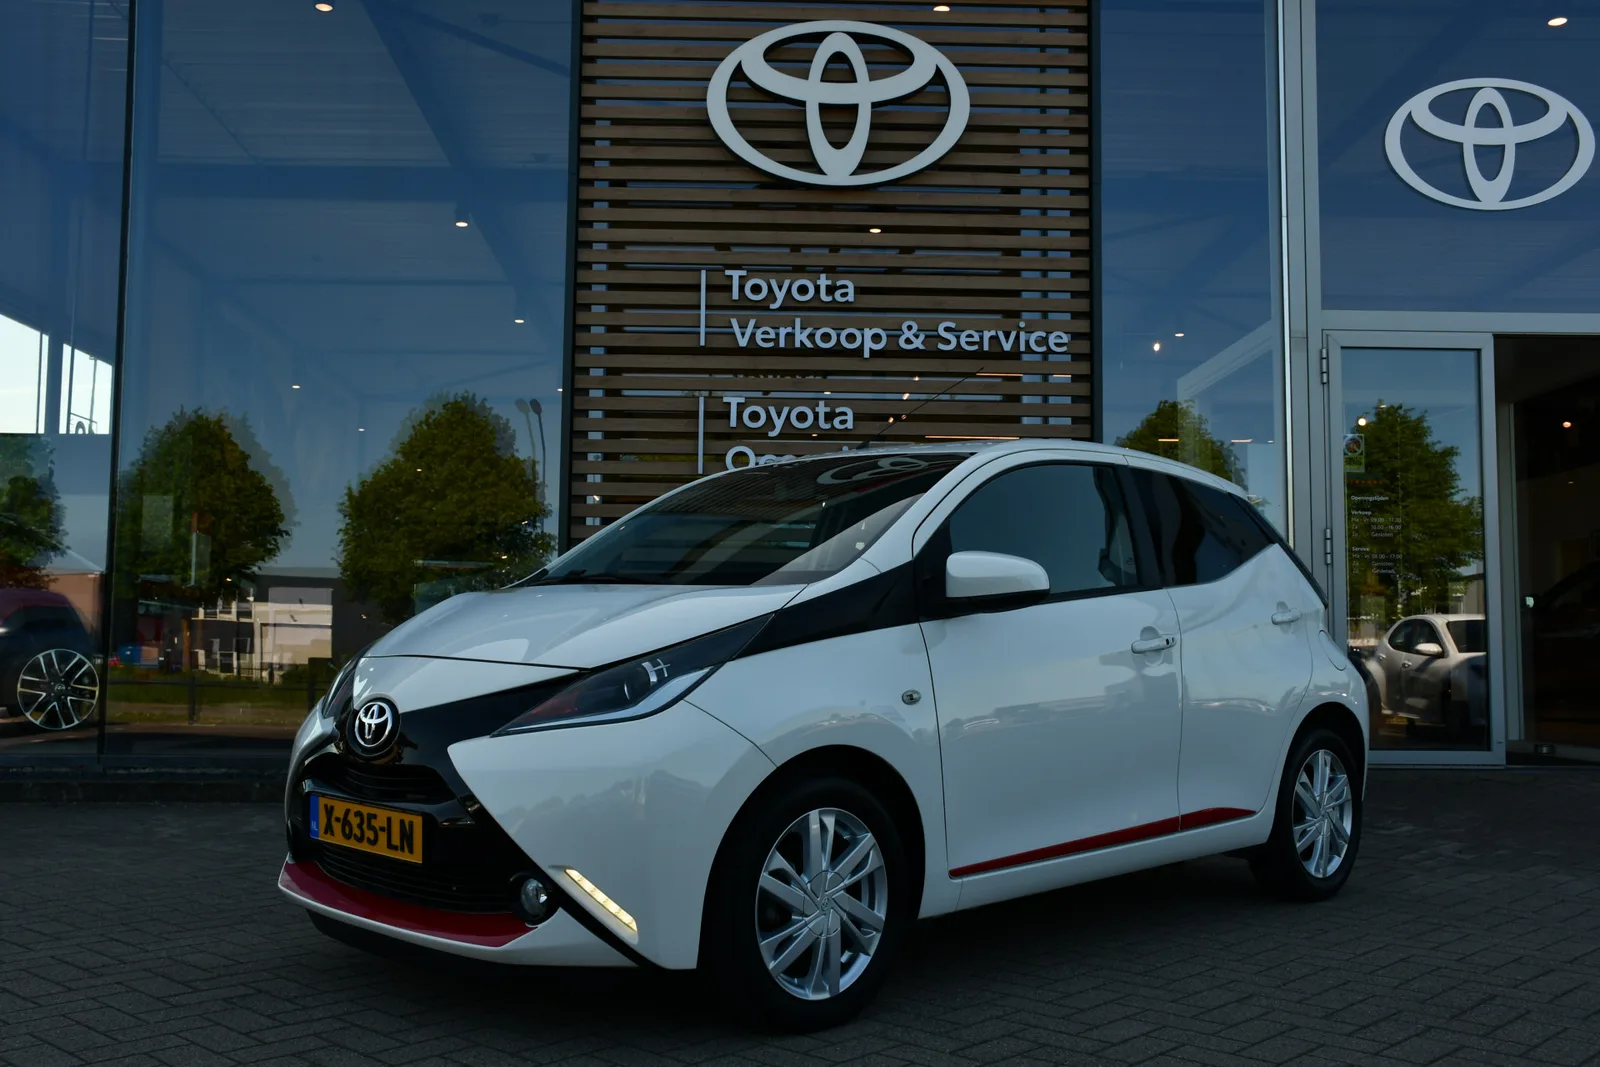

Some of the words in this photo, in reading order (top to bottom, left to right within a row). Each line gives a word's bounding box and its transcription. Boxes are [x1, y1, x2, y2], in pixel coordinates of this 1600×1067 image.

[724, 269, 855, 309] Toyota
[730, 318, 888, 358] Verkoop
[898, 320, 926, 350] &
[937, 321, 1069, 353] Service
[723, 396, 854, 437] Toyota
[323, 803, 414, 855] X-635-LN
